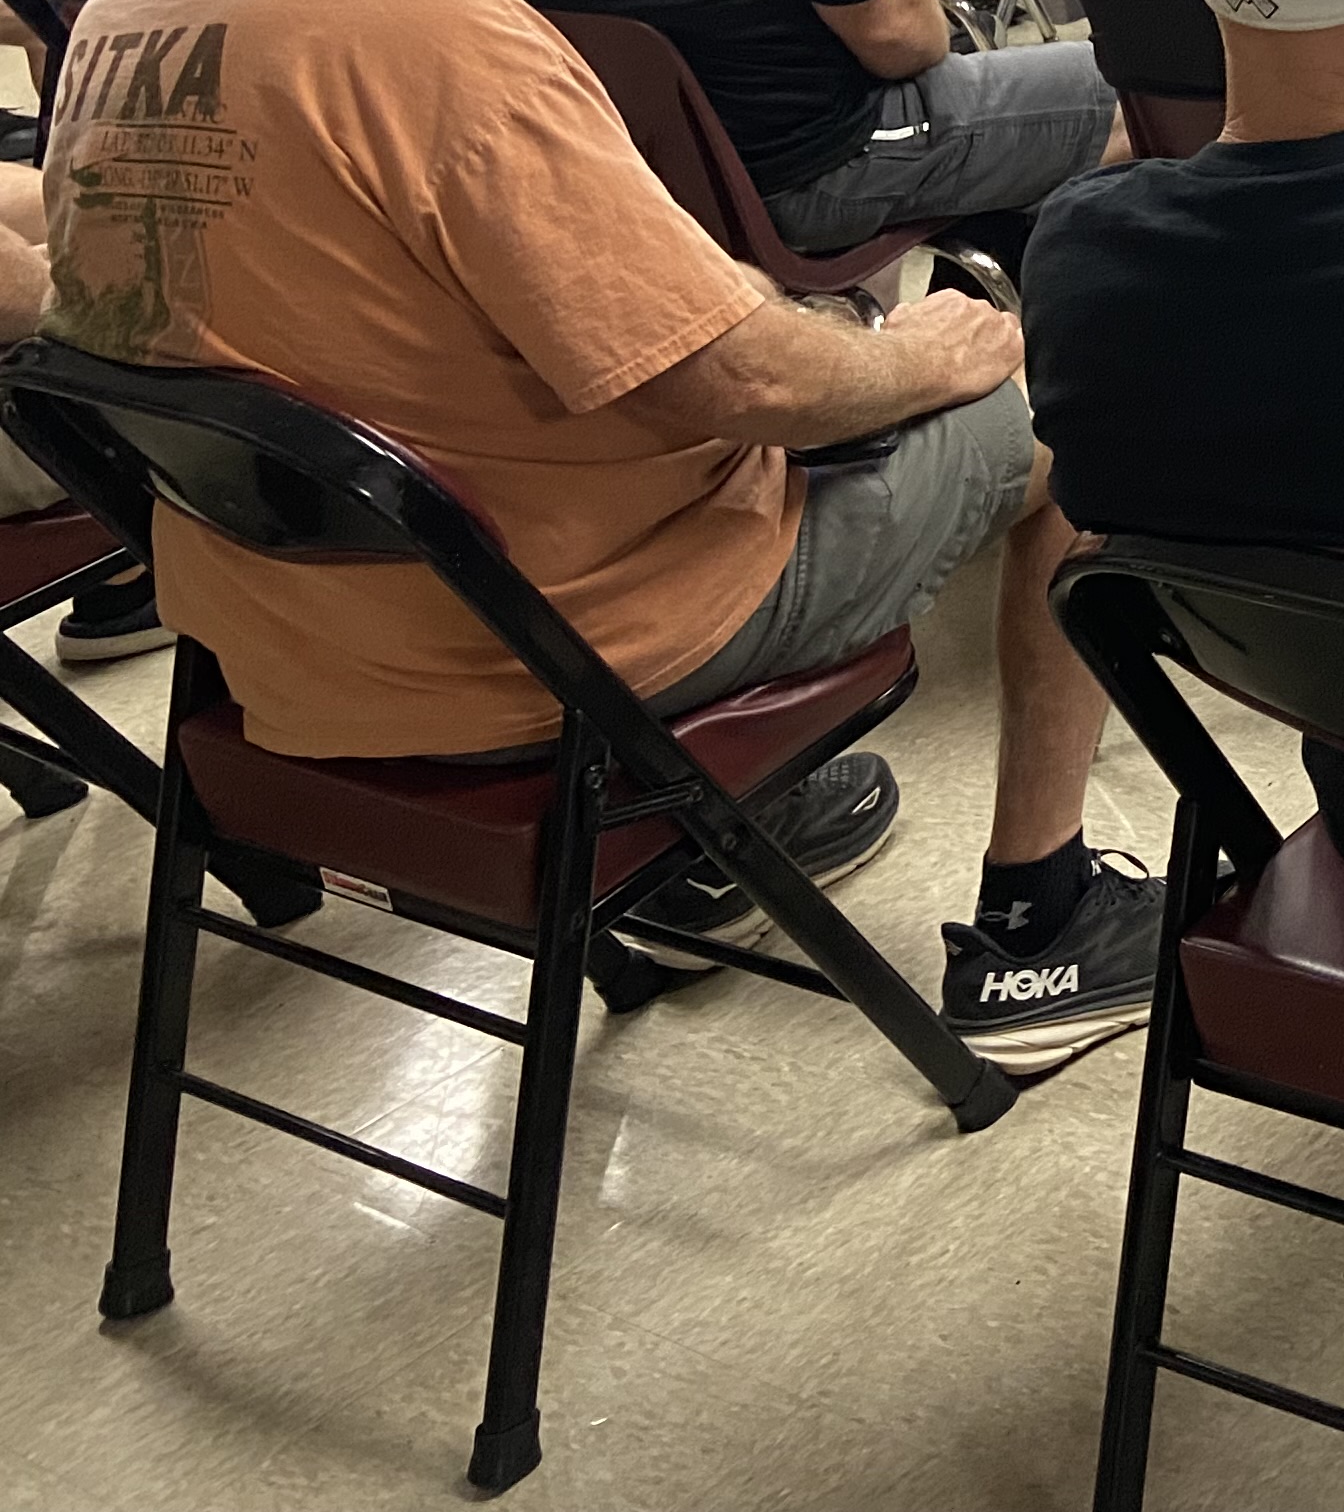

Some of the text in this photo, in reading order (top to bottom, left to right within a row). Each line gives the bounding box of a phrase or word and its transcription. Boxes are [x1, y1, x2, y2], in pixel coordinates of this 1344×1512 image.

[54, 22, 228, 128] SITKA
[239, 138, 258, 162] N
[233, 176, 254, 197] W
[980, 964, 1079, 1003] HOKA
